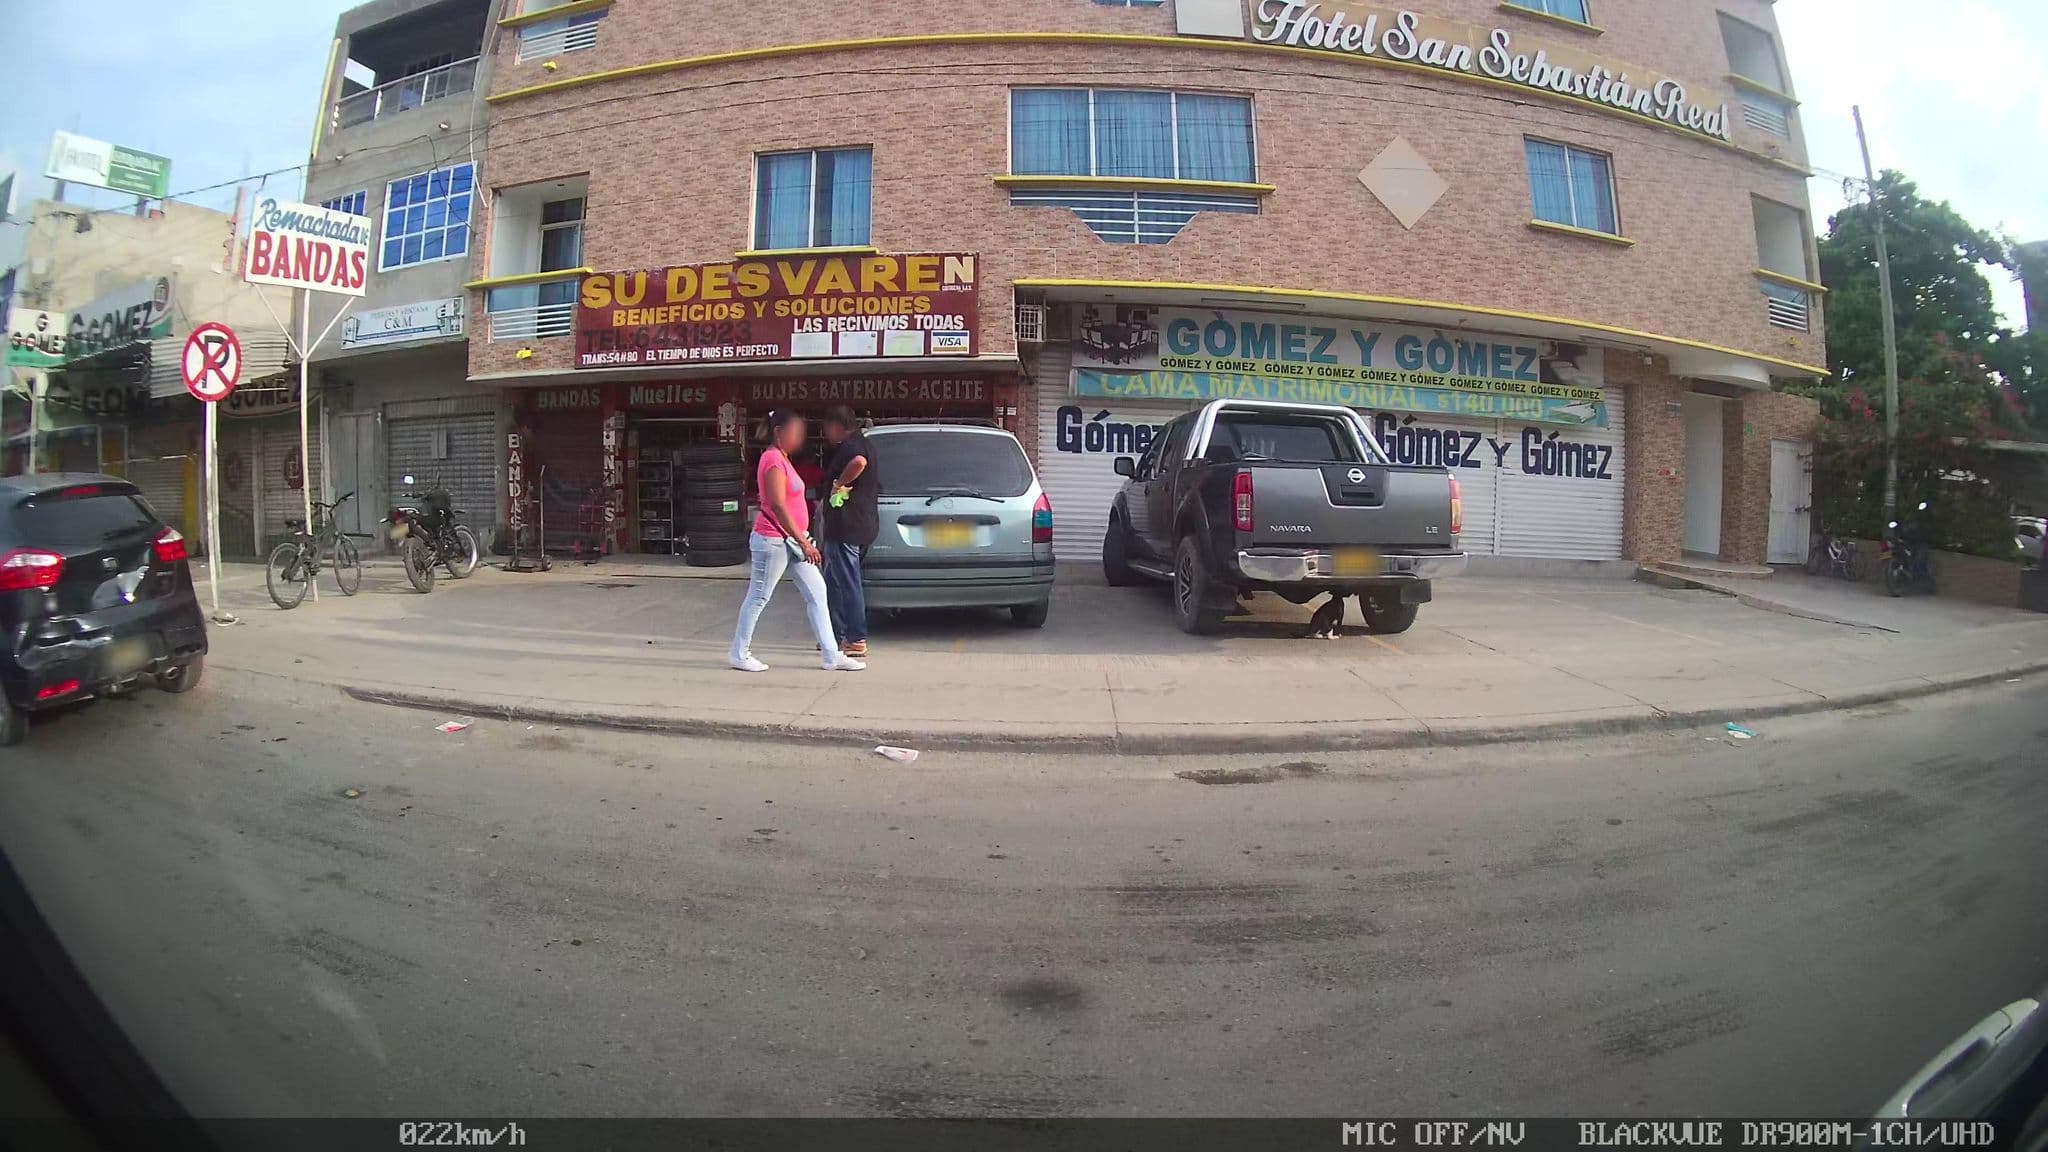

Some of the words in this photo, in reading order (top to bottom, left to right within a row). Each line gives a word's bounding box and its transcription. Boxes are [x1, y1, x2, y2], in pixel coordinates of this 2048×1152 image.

[1252, 0, 1377, 54] Hotel
[1382, 11, 1471, 71] San
[1479, 28, 1651, 115] Sebastián
[1653, 79, 1731, 139] Real
[254, 198, 359, 244] Remachada
[250, 230, 366, 289] BANDAS
[581, 271, 647, 310] SU
[612, 302, 745, 327] BENEFICIOS
[753, 300, 767, 318] Y
[774, 296, 931, 317] SOLUCIONES
[794, 318, 824, 333] LAS
[827, 315, 909, 332] RECIVIMOS
[914, 314, 964, 330] TODAS
[646, 350, 656, 361] EL
[658, 348, 687, 360] TIEMPO
[689, 347, 701, 359] DE
[702, 346, 721, 358] DIOS
[722, 345, 734, 357] ES
[735, 344, 779, 357] PERFECTO
[937, 337, 962, 346] VISA
[1351, 329, 1381, 367] Y
[1204, 360, 1213, 369] Y
[537, 389, 600, 408] BANDAS
[629, 384, 707, 406] Muelles
[752, 381, 808, 401] BUJES
[818, 379, 910, 400] BATERIAS
[919, 379, 985, 401] ACEITE
[1101, 371, 1201, 395] CAMA
[1208, 374, 1425, 410] MATRIMONIAL
[1521, 426, 1612, 480] Gómez
[1270, 525, 1312, 533] NAVARA
